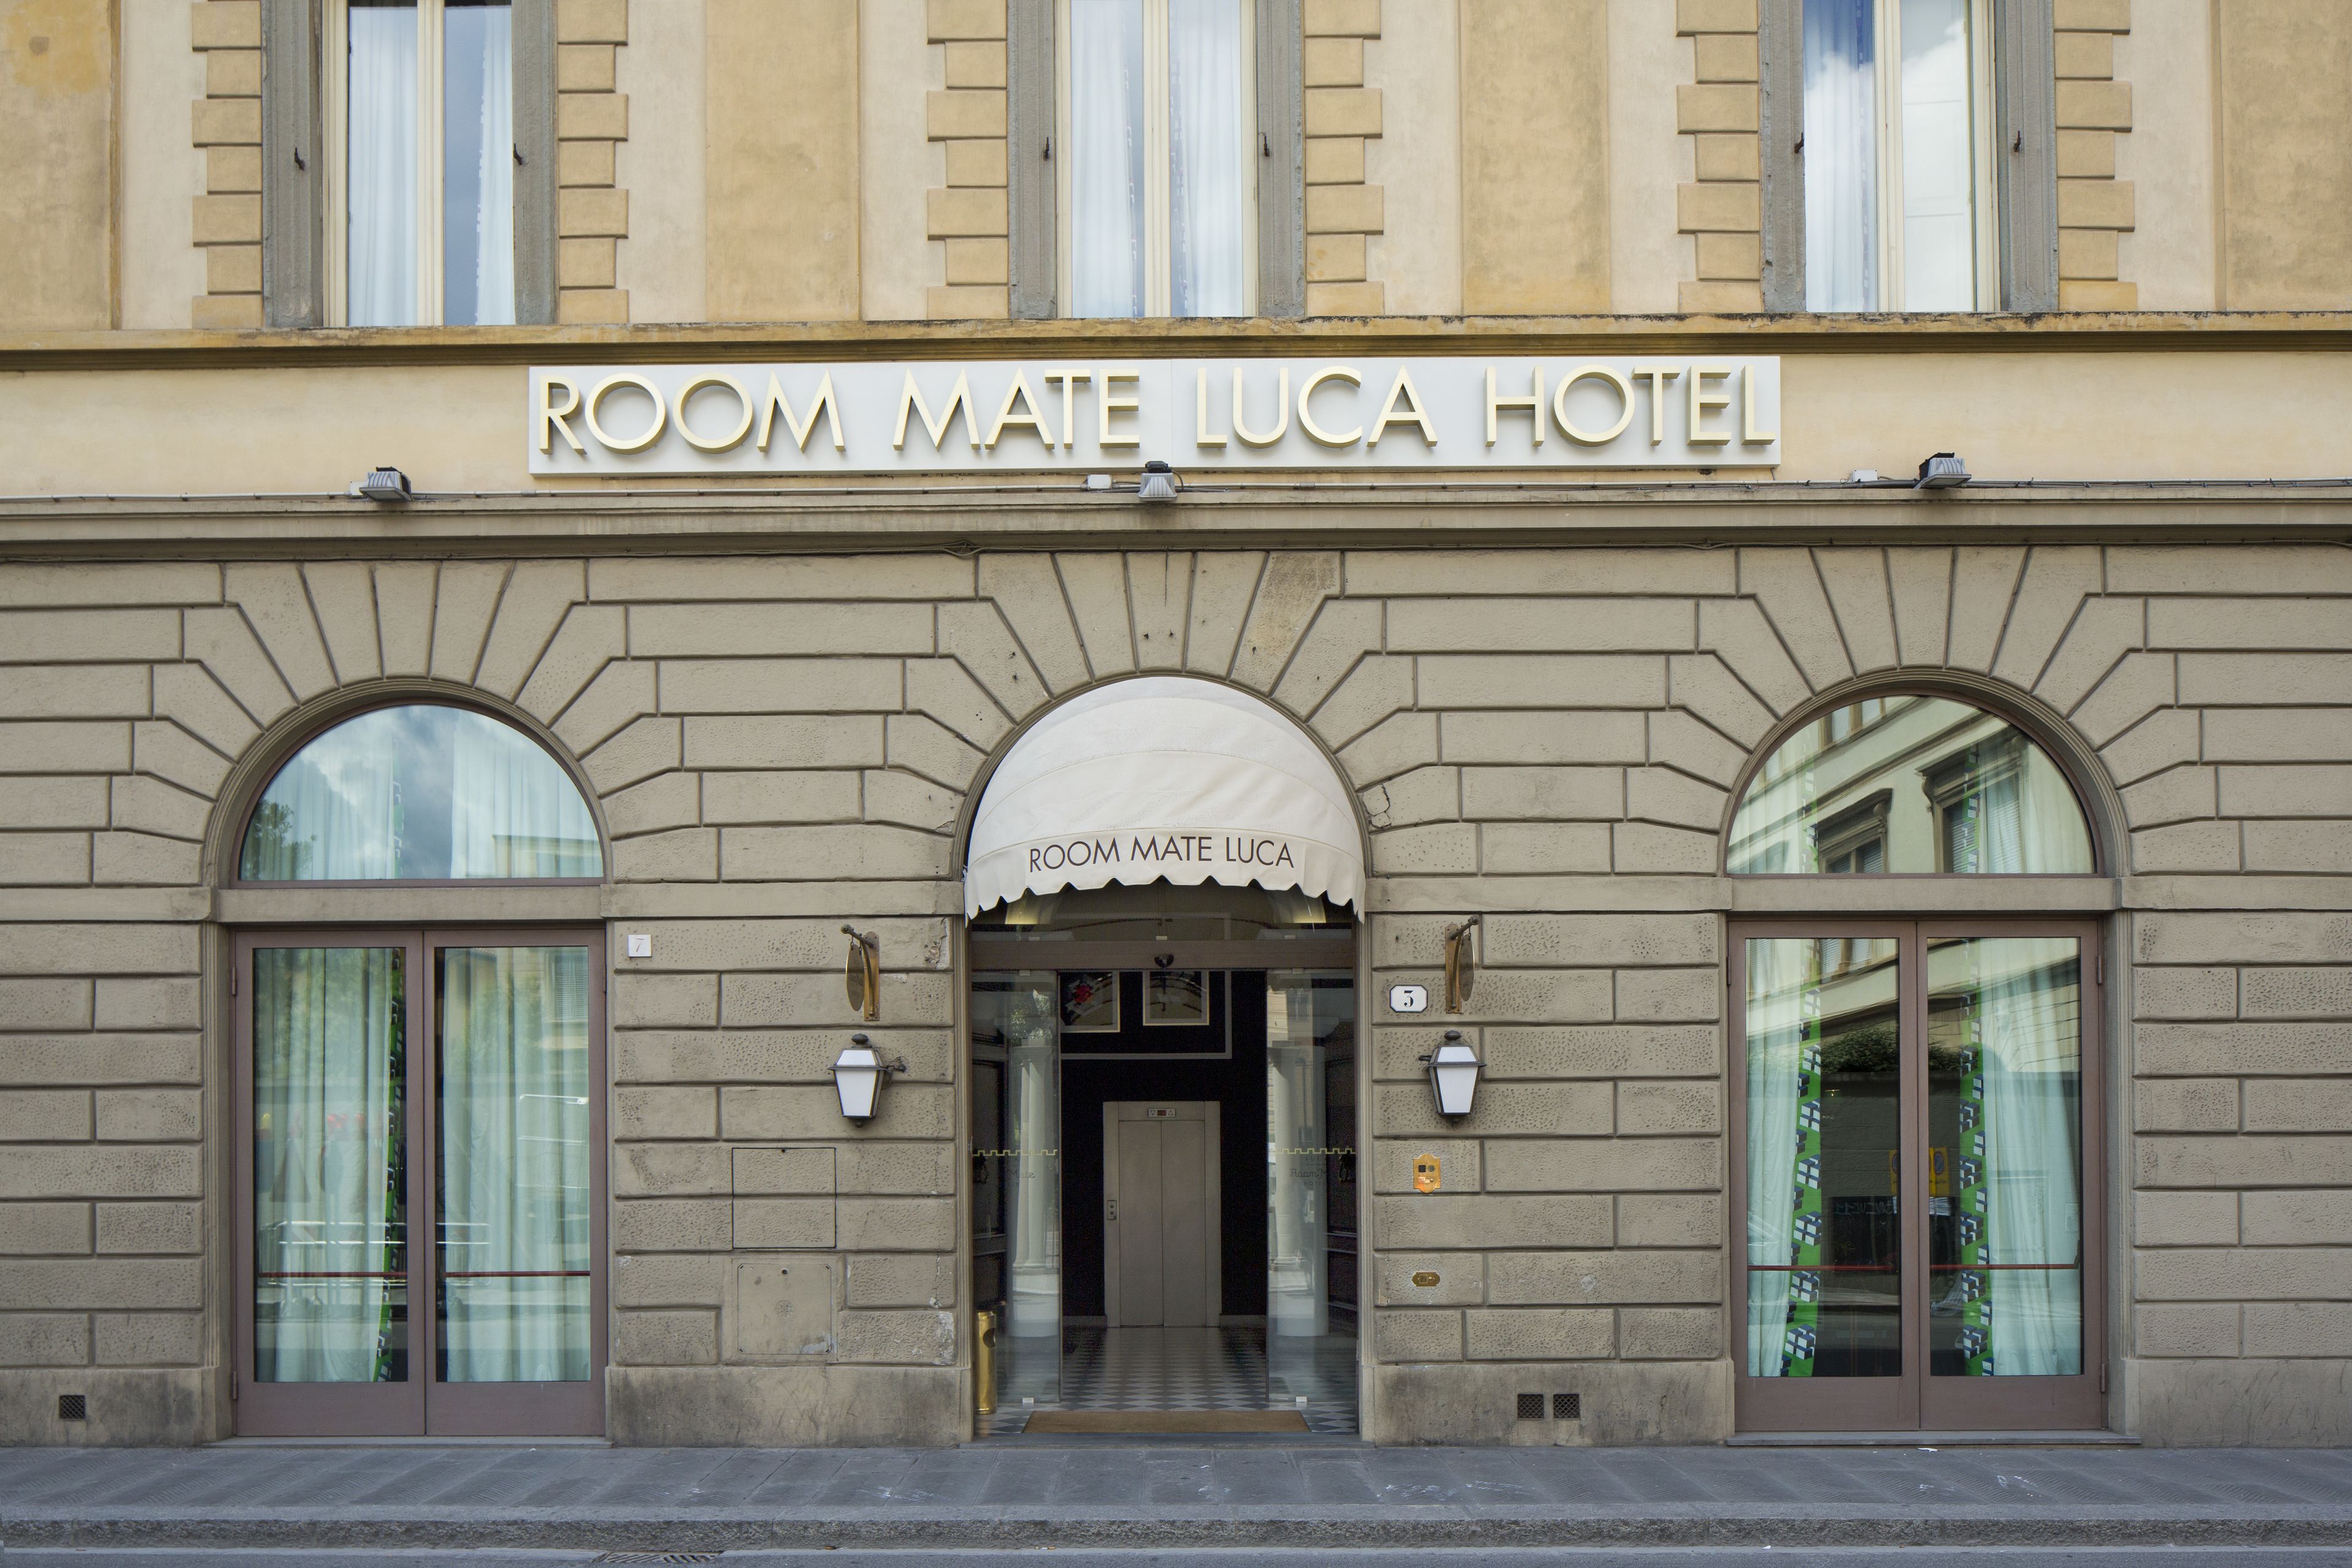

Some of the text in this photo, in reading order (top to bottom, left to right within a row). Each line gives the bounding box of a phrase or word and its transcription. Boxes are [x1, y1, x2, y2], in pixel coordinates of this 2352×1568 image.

[540, 364, 1776, 456] ROOM MATE LUCA HOTEL
[1029, 835, 1295, 873] ROOM MATE LUCA
[635, 938, 645, 952] 7
[1404, 990, 1414, 1008] 3
